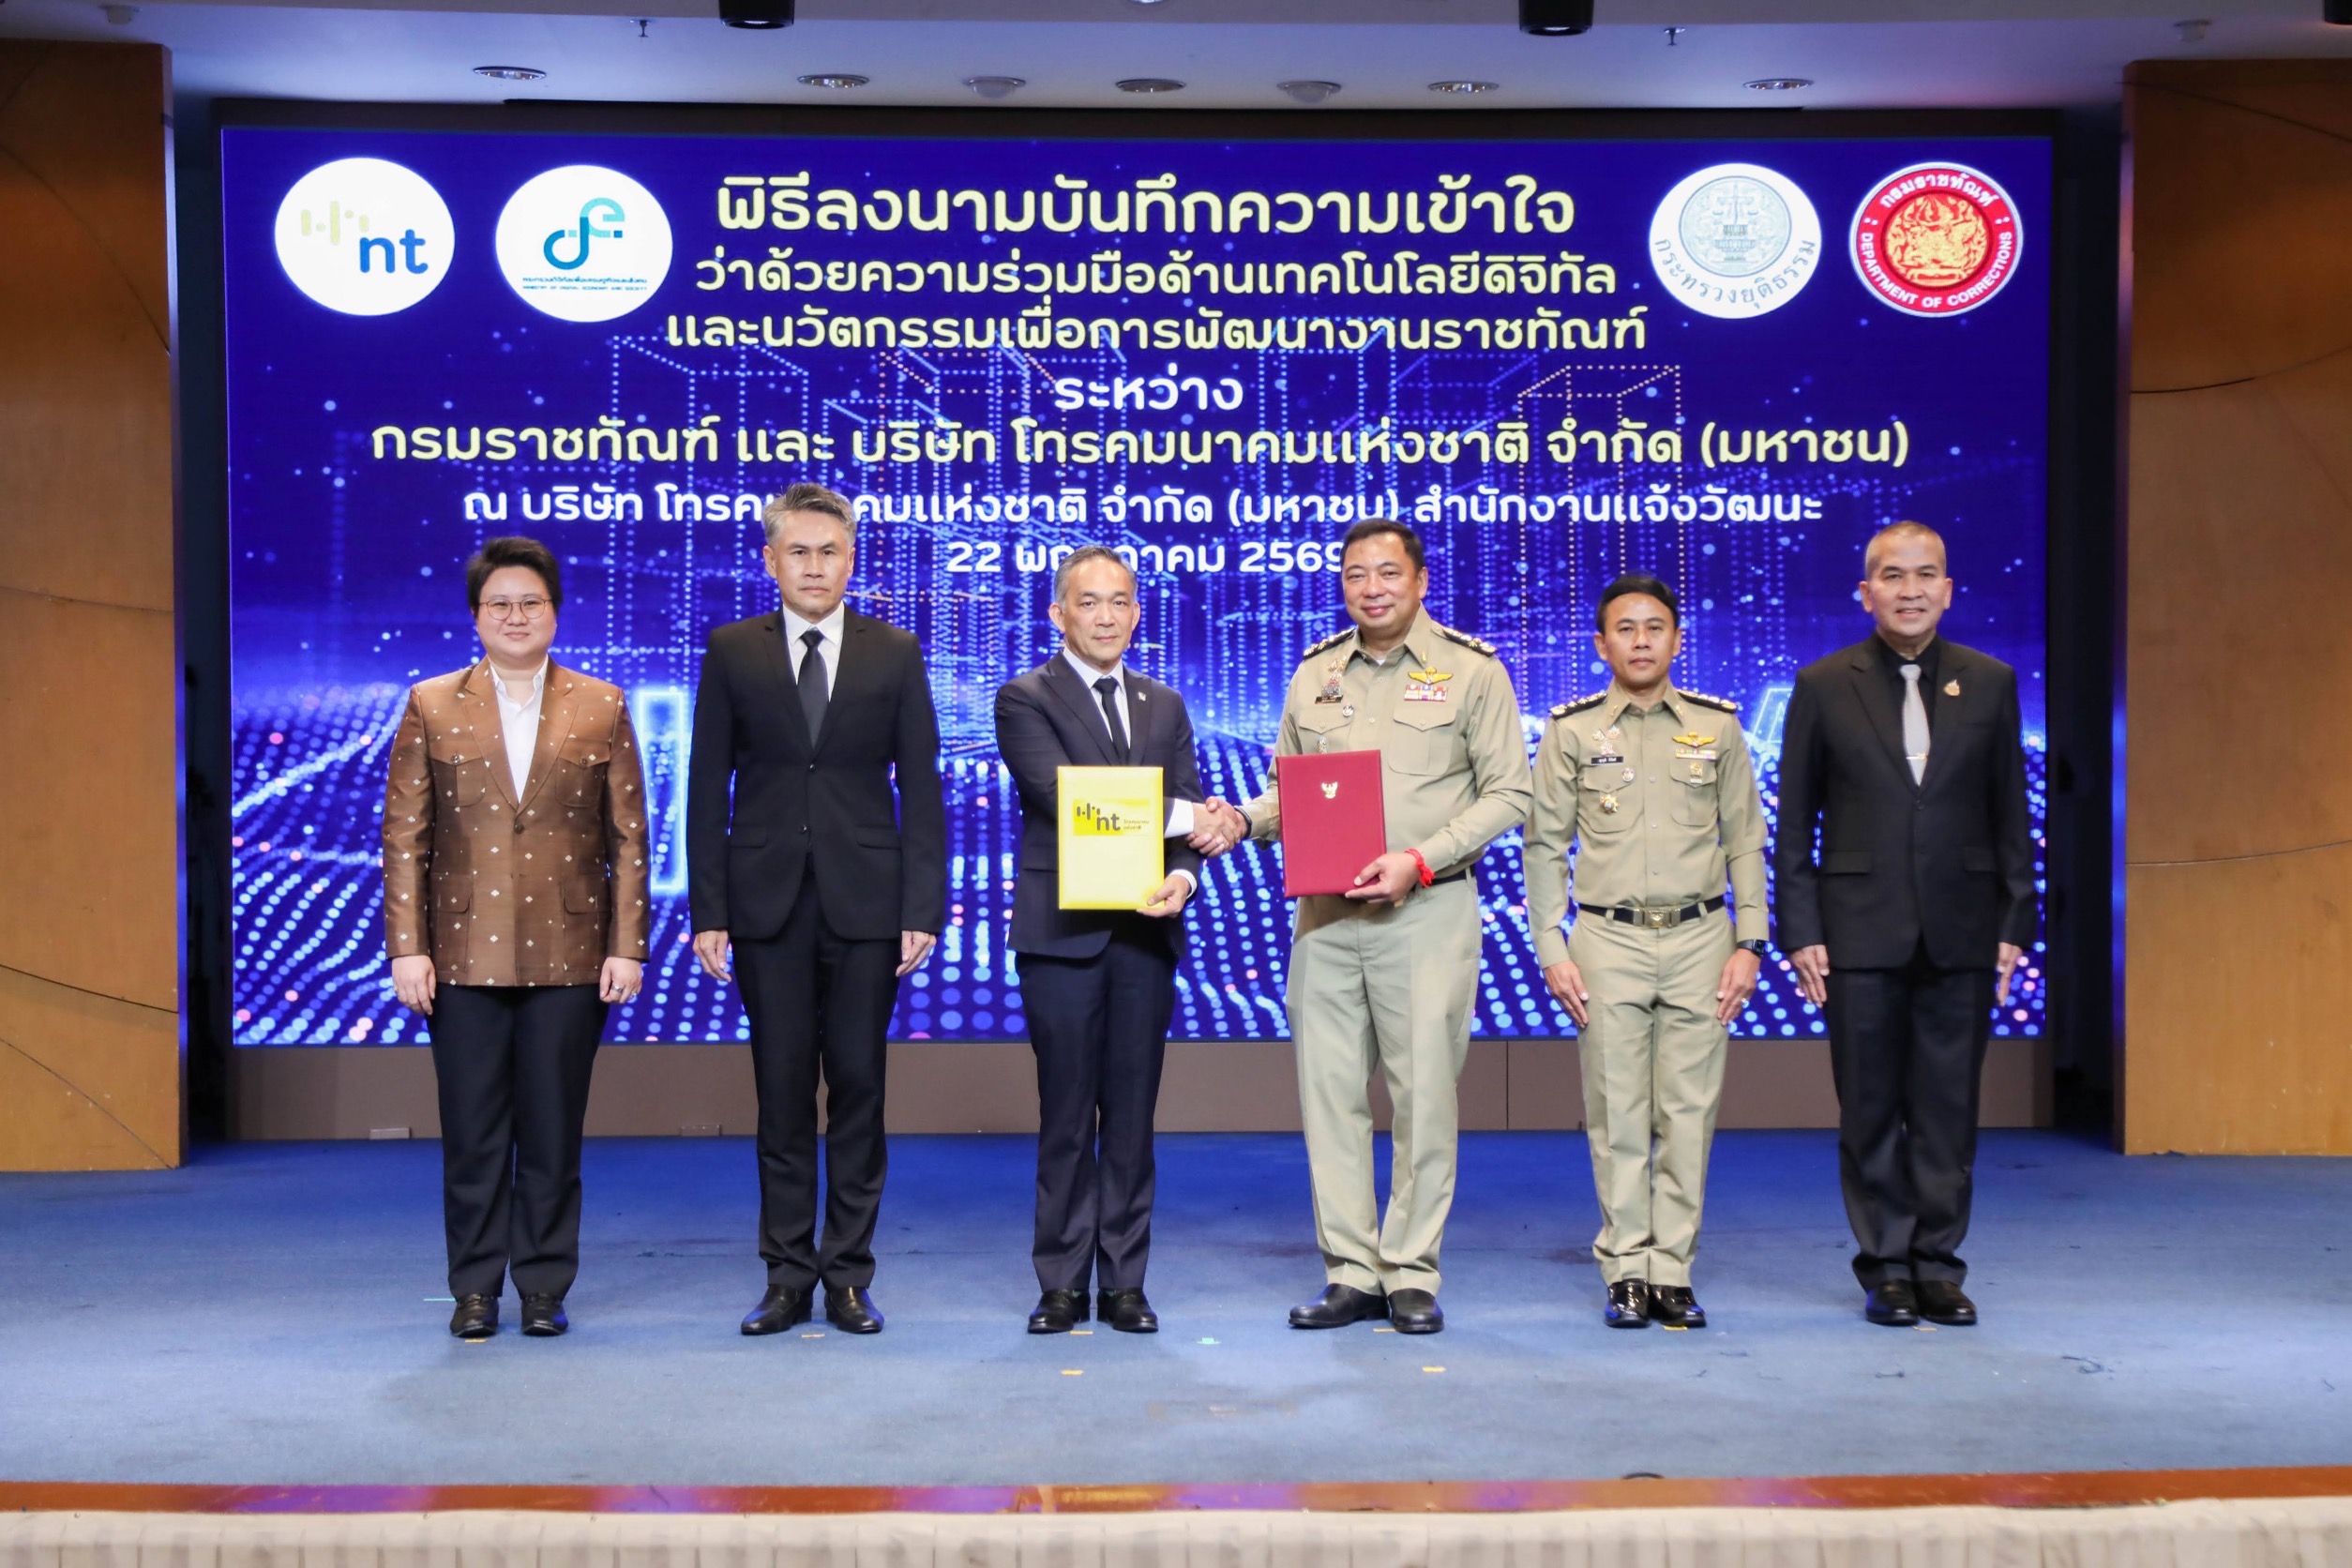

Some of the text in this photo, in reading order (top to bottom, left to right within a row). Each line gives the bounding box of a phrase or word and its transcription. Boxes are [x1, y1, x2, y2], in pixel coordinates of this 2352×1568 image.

[717, 170, 1576, 233] พิธีลงนามบันทึกความเข้าใจ
[1879, 173, 1999, 209] กรมราชทัณฑ์
[359, 229, 429, 274] nt
[696, 245, 1617, 294] ว่าด้วยความร่วมมือด้านเทคโนโลยีดิจิทัล
[1654, 239, 1817, 309] กระทรวงยุติธรรม
[1861, 231, 2013, 308] DEPARTMENT OF CORRECTIONS
[667, 294, 1649, 350] และนวัตกรรมเพื่อการพัฒนางานราชทัณฑ์
[1053, 362, 1244, 411] ระหว่าง
[371, 415, 1909, 468] กรมราชทัณฑ์ และ บริษัท โทรคมนาคมแห่งชาติ จำกัด (มหาชน)
[464, 491, 507, 521] ณ
[521, 484, 643, 521] บริษัท
[1100, 484, 1214, 523] จำกัด
[1228, 488, 1399, 527] (มหาชน)
[1413, 483, 1823, 522] สำนักงานแจ้งวัฒนะ
[945, 541, 1003, 572] 22
[1096, 813, 1121, 831] nt
